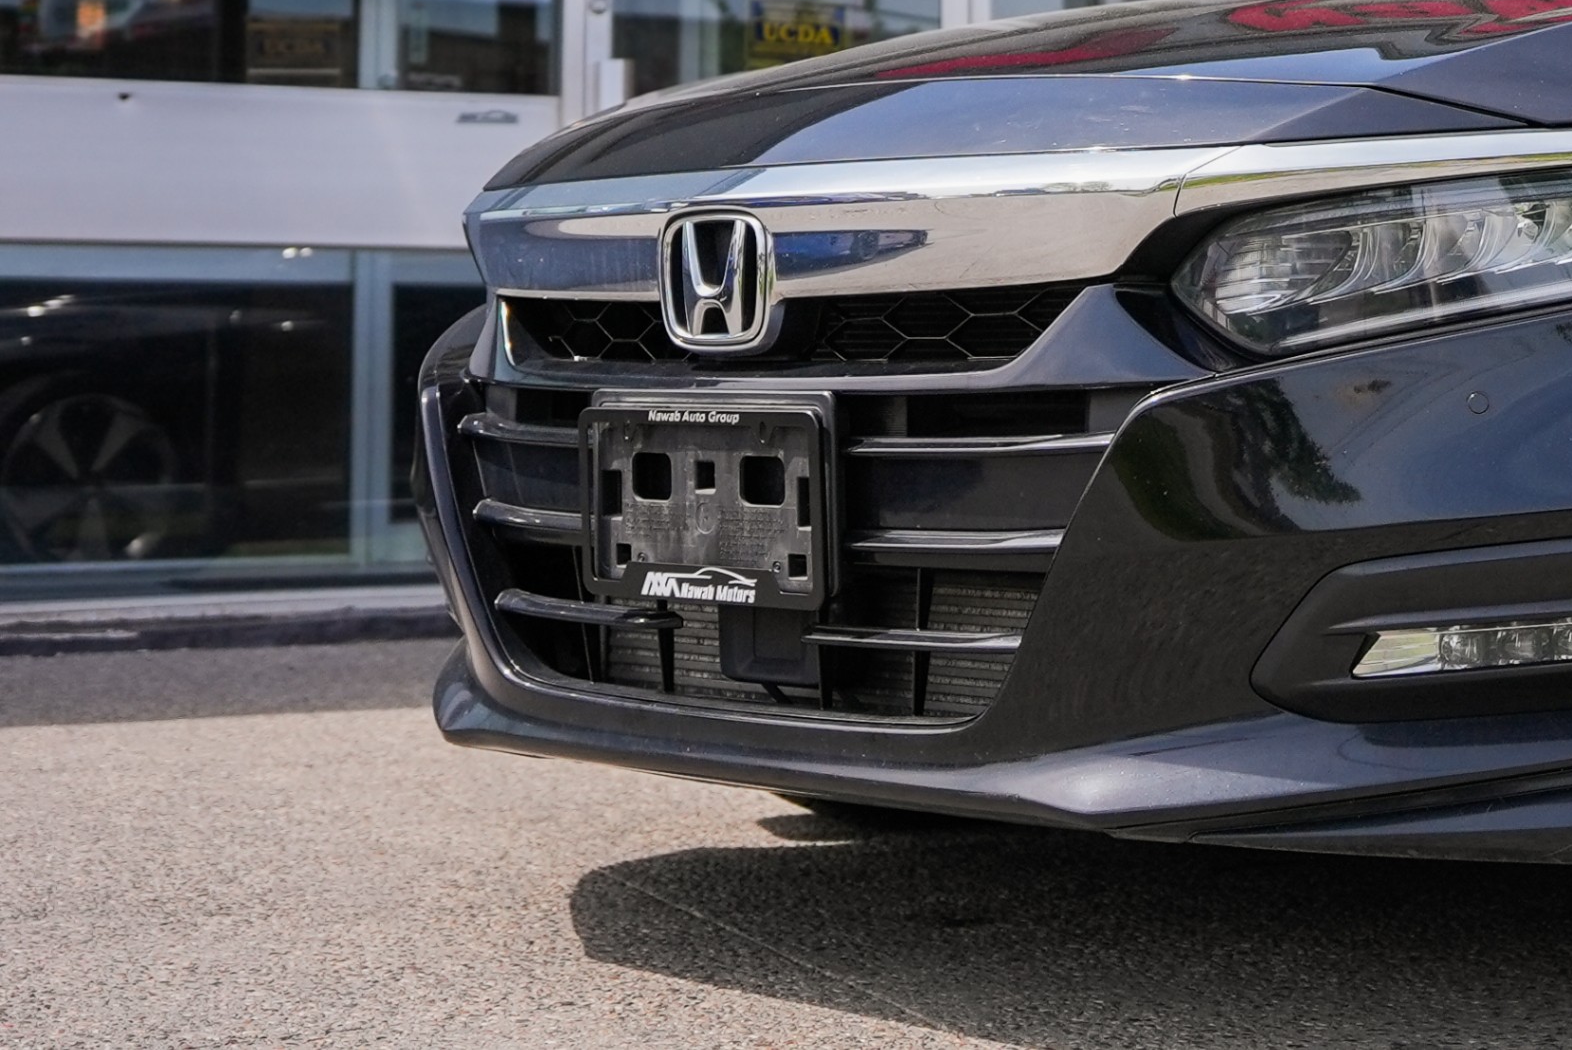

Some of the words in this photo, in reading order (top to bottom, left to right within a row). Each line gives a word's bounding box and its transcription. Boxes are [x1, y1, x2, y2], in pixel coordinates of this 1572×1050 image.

[763, 20, 835, 46] UCDA
[648, 410, 681, 423] Nawab
[681, 410, 706, 423] Auto
[708, 411, 740, 425] Group
[681, 582, 716, 600] Nawab
[715, 584, 756, 603] Motors
